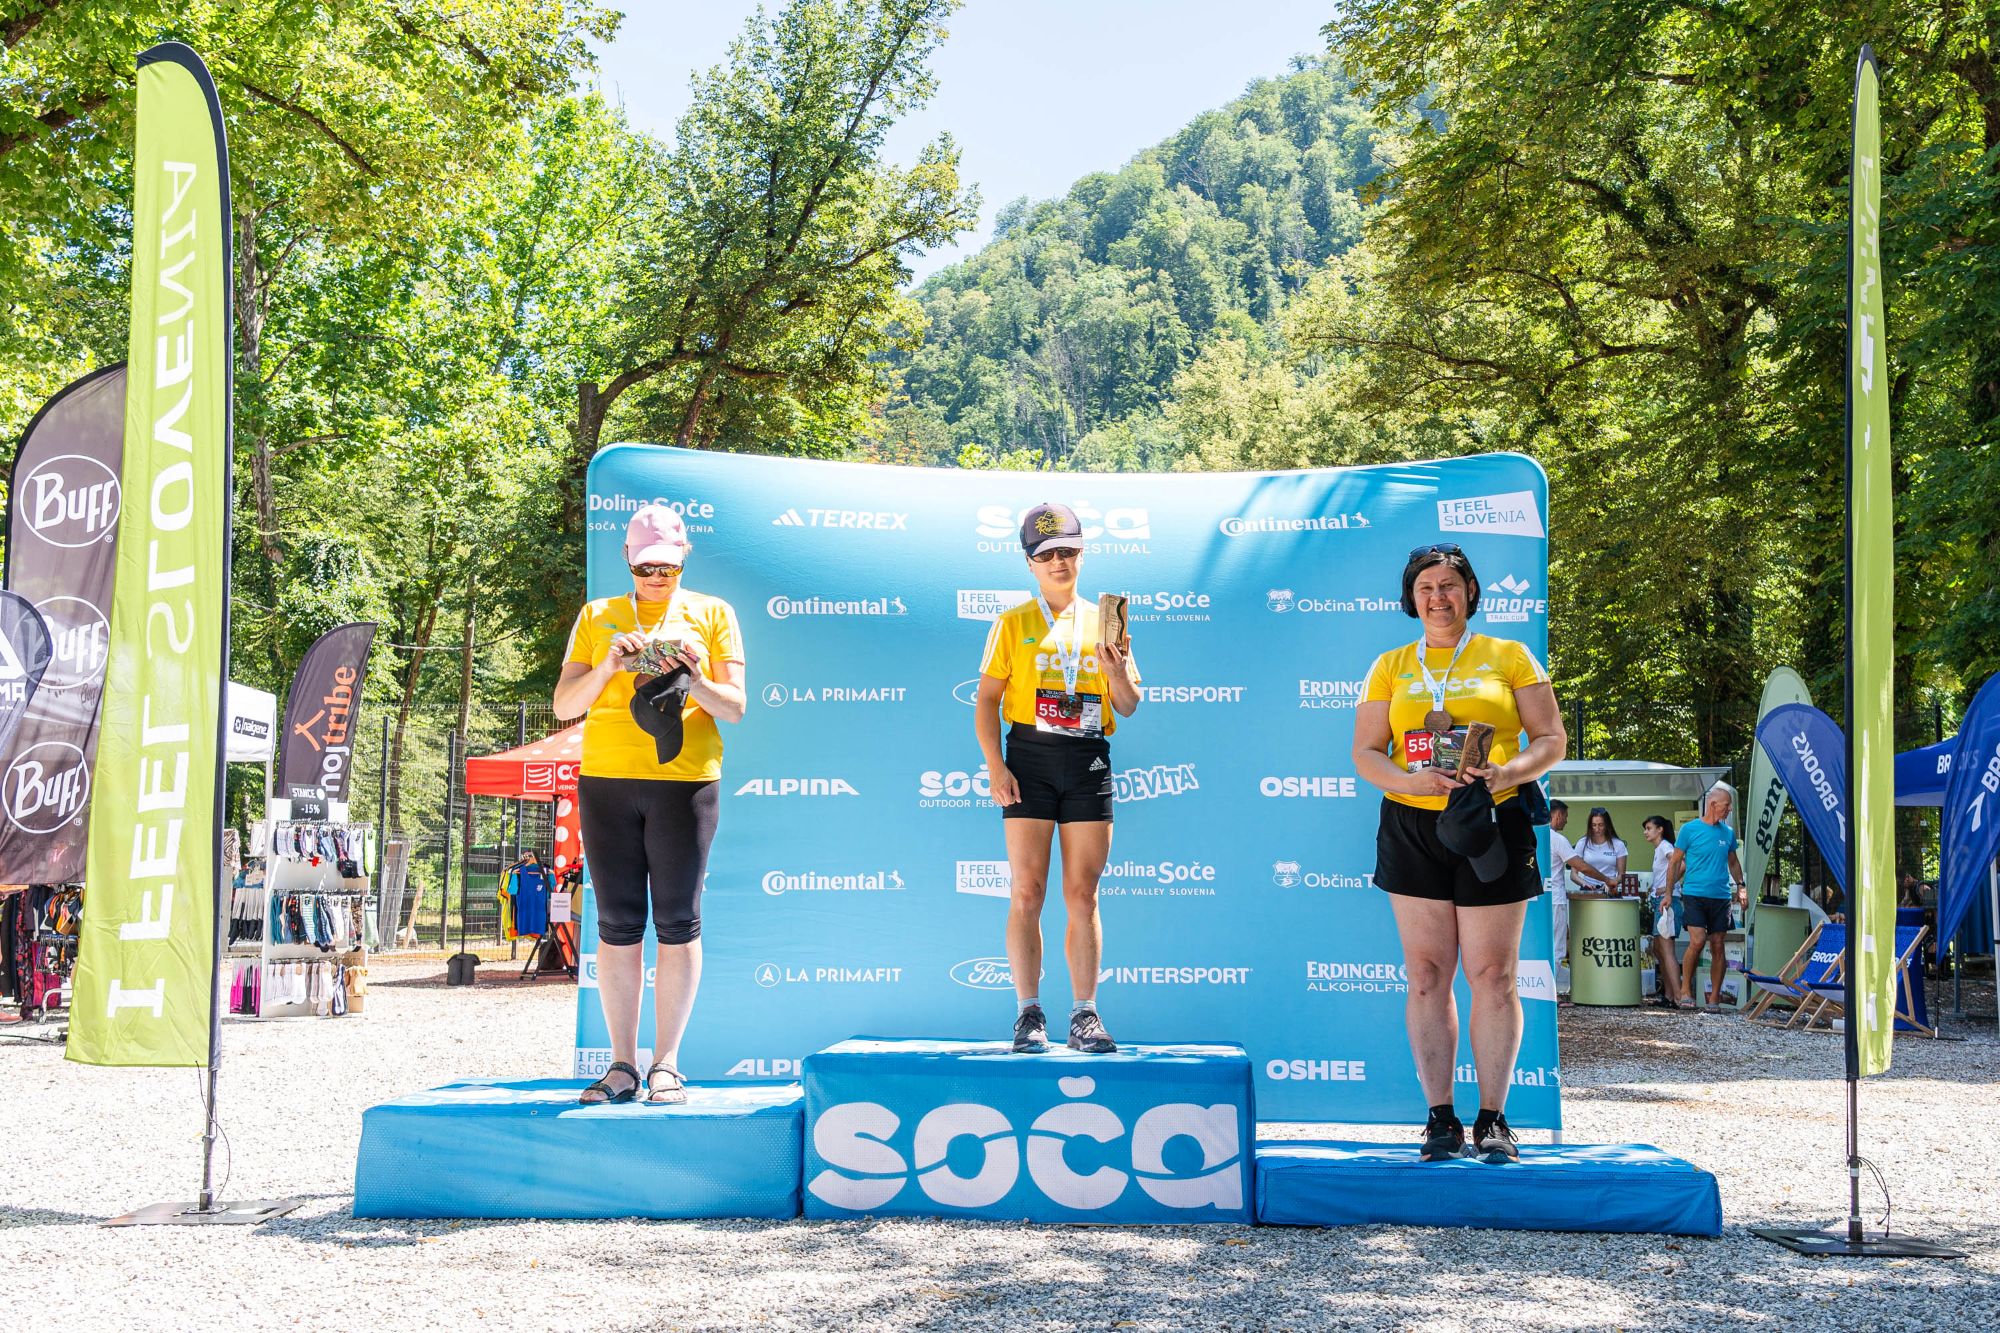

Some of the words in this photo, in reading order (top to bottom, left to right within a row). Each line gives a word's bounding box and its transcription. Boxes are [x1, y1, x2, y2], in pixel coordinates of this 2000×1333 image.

[1442, 503, 1449, 514] I
[1453, 499, 1493, 513] FEEL
[807, 508, 909, 530] TERREX
[975, 500, 1152, 541] sča
[1218, 513, 1349, 537] Continental
[1444, 509, 1526, 527] SLOVENIA
[588, 521, 617, 531] SOČA
[685, 524, 715, 534] VENIA
[976, 541, 1024, 554] OUTD
[1081, 542, 1152, 555] ESTIVAL
[960, 592, 966, 603] I
[969, 592, 1000, 604] FEEL
[1154, 591, 1211, 611] Soče
[1298, 598, 1355, 613] Občina
[1355, 597, 1403, 612] Tolm
[767, 595, 888, 619] Continental
[960, 603, 1014, 615] SLOVEN
[1166, 614, 1211, 623] SLOVENIA
[1489, 613, 1510, 621] TRAIL
[1035, 651, 1099, 675] soa
[792, 687, 816, 702] LA
[822, 686, 907, 703] PRIMAFIT
[1137, 686, 1248, 703] TERSPORT
[1299, 679, 1361, 698] ERDING
[917, 763, 992, 798] soč
[1112, 763, 1200, 803] DEVITA
[1259, 776, 1357, 798] OSHEE
[291, 787, 317, 799] STANCE
[300, 803, 321, 815] -15%
[918, 799, 971, 808] OUTDOOR
[960, 864, 966, 876] I
[969, 864, 1000, 876] FEEL
[1100, 860, 1157, 878] Dolina
[1157, 860, 1216, 884] Soče
[761, 870, 886, 896] Continental
[960, 876, 1012, 889] SLOVEN
[1304, 872, 1363, 888] Občina
[1101, 885, 1127, 896] SOČA
[1131, 887, 1165, 897] VALLEY
[1169, 887, 1216, 897] SLOVENIA
[1582, 936, 1636, 957] gema
[1593, 948, 1633, 968] vita
[785, 967, 810, 983] LA
[815, 967, 902, 983] PRIMAFIT
[1116, 966, 1250, 985] INTERSPORT
[1306, 960, 1398, 980] ERDINGER
[1306, 982, 1408, 993] ALKOHOLFR
[1517, 975, 1545, 988] ENIA
[578, 1051, 584, 1062] I
[588, 1051, 612, 1062] FEE
[724, 1058, 802, 1077] ALPI
[1265, 1059, 1366, 1081] OSHEE
[807, 1075, 1244, 1211] soča
